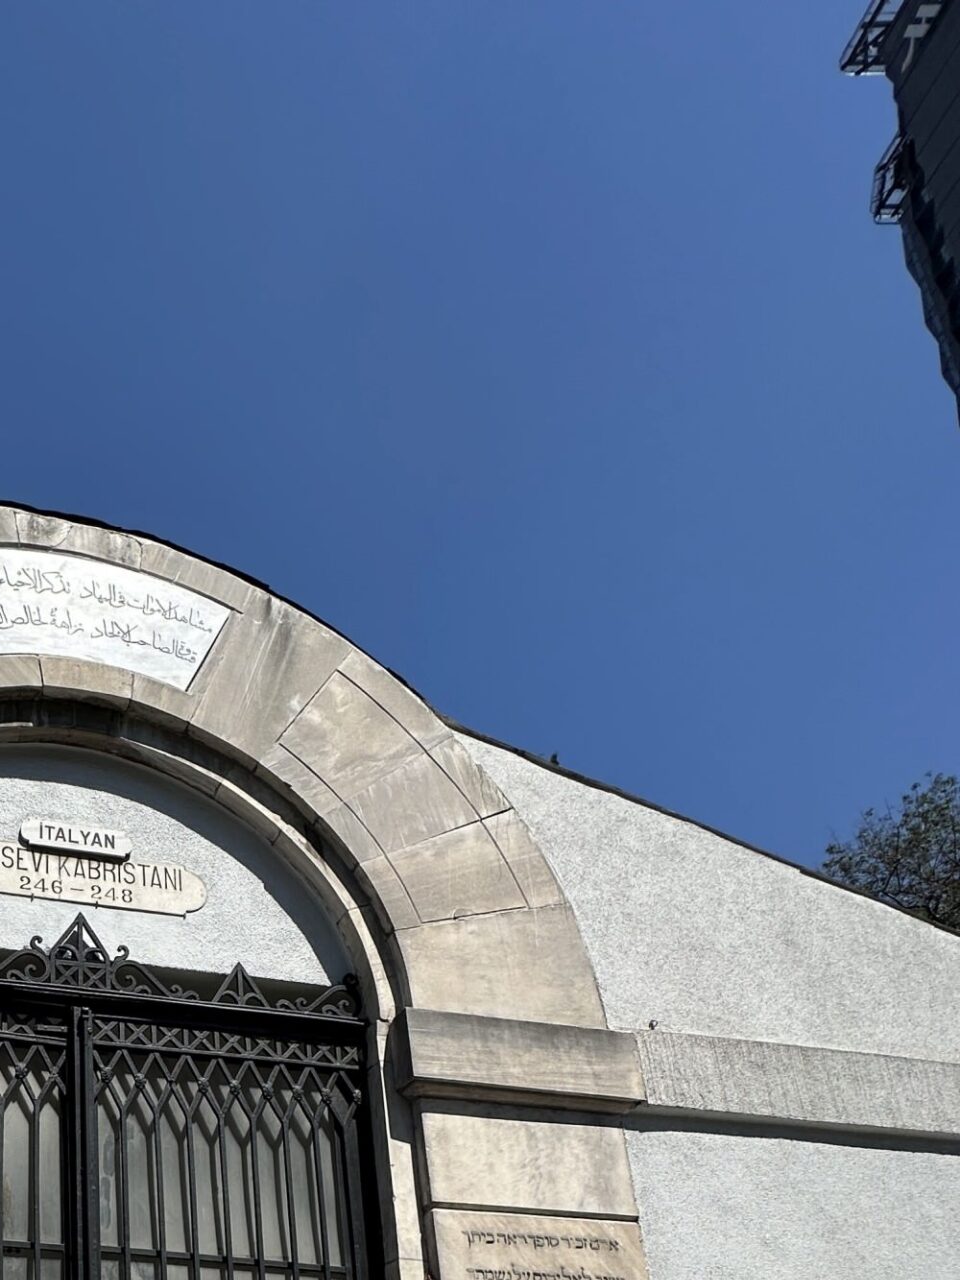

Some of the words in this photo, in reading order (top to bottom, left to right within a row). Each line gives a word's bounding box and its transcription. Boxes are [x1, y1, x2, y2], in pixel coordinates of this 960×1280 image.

[39, 822, 115, 849] İTALYAN
[20, 876, 63, 894] 246
[91, 885, 133, 903] 248
